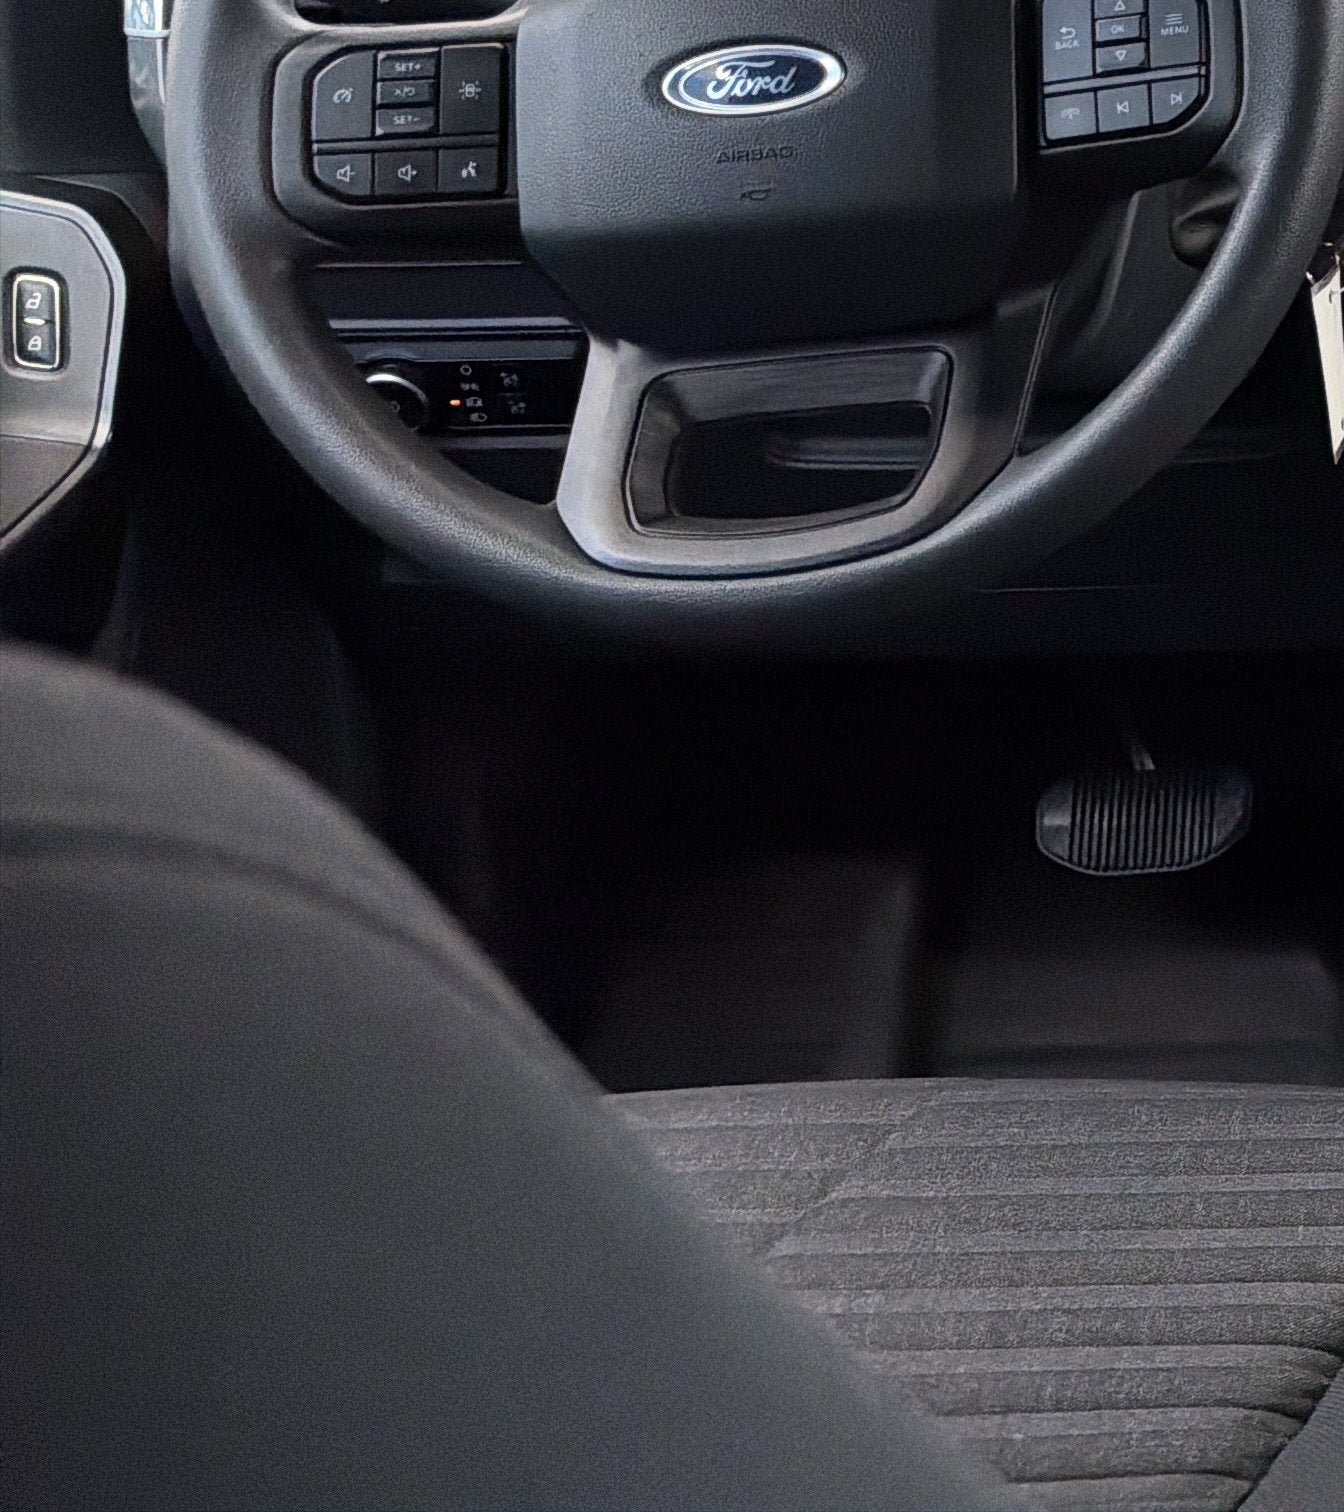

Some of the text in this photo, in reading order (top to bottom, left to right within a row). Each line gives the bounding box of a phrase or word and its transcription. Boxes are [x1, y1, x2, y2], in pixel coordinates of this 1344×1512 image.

[1110, 24, 1125, 34] OK
[1160, 26, 1189, 36] MENU
[1054, 40, 1080, 50] BACK
[706, 60, 798, 100] Ford
[716, 146, 794, 164] AIRBAG
